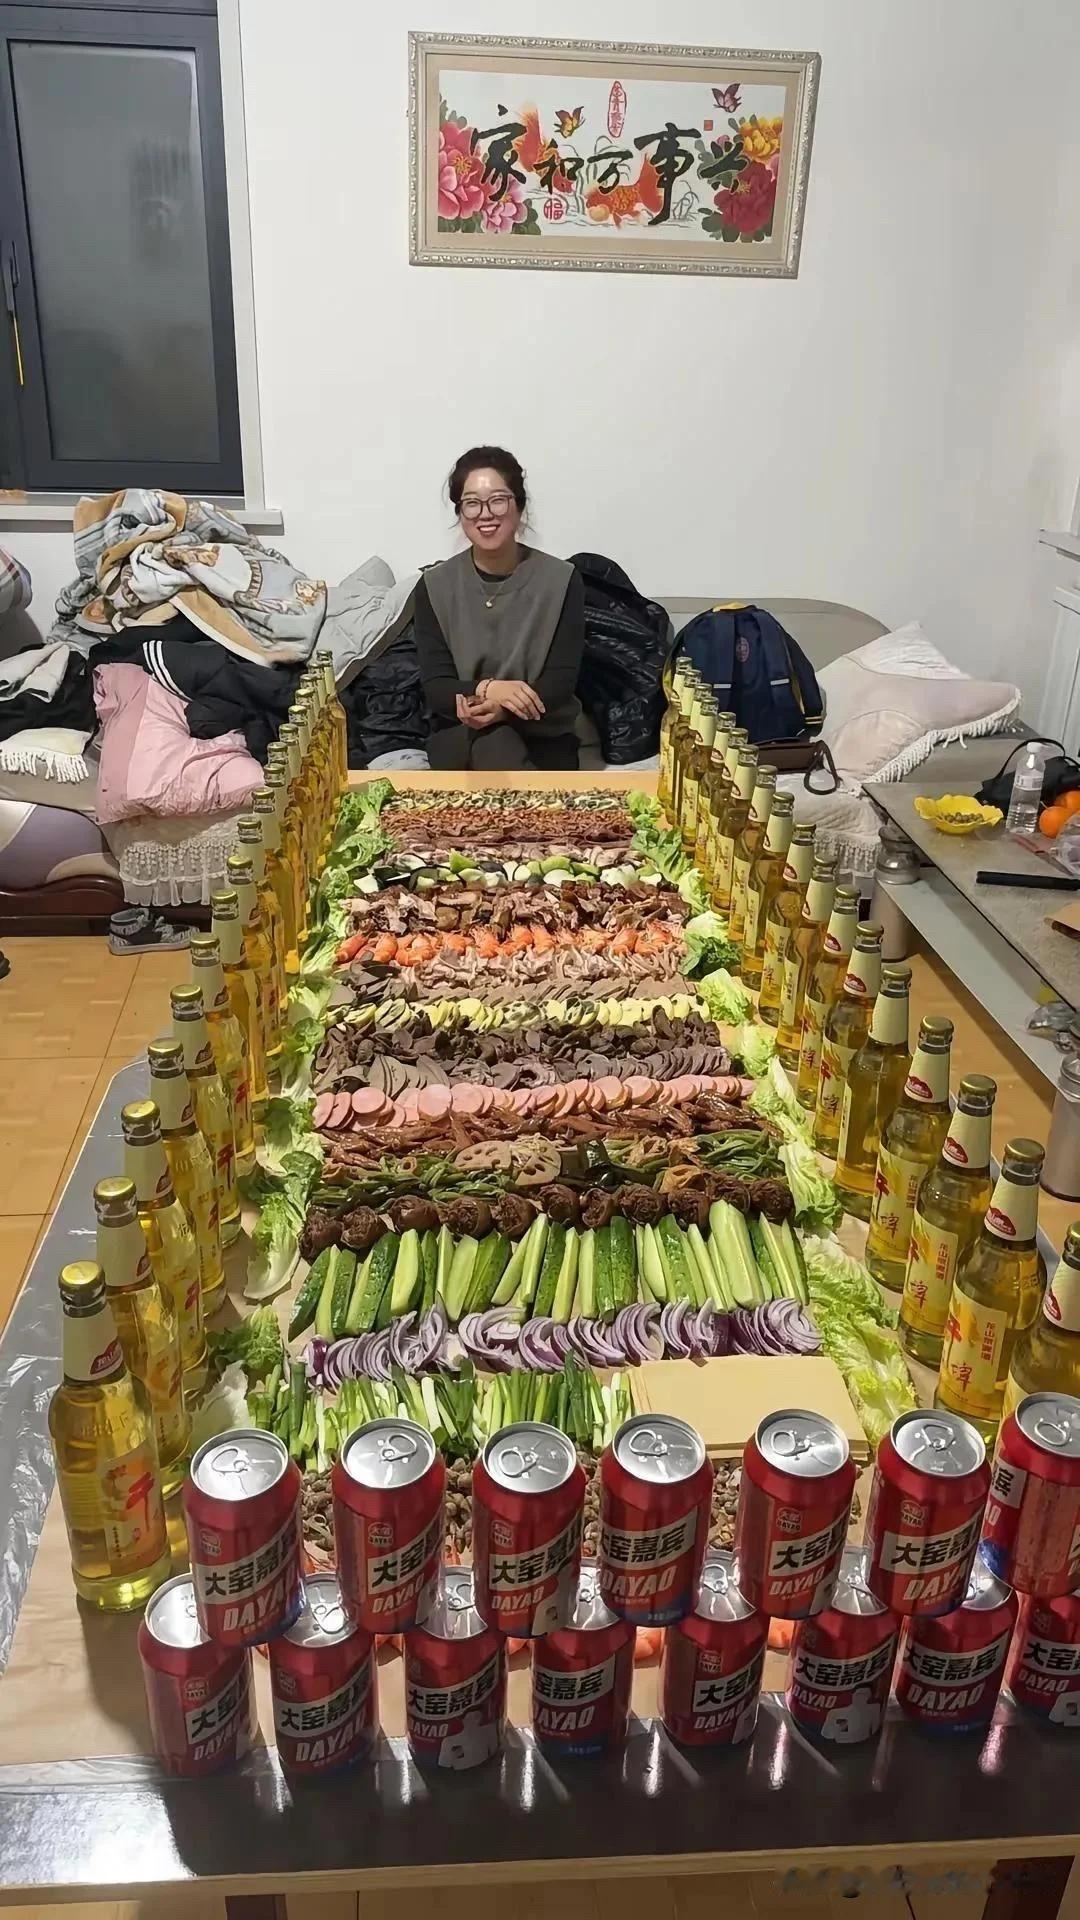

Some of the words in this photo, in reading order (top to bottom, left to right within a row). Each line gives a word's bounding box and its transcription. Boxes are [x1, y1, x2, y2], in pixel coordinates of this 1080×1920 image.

[470, 103, 751, 226] 家和万事兴
[371, 1572, 425, 1614] DAYAO
[600, 1565, 678, 1598] DAYAO
[769, 1565, 825, 1596] DAYAO
[491, 1585, 545, 1611] DAYAO
[795, 1643, 892, 1687] 大窑嘉宾
[906, 1681, 987, 1711] DAYAO
[1018, 1668, 1070, 1694] DAYAO
[791, 1684, 838, 1709] DAYAO
[408, 1719, 449, 1739] AYAO
